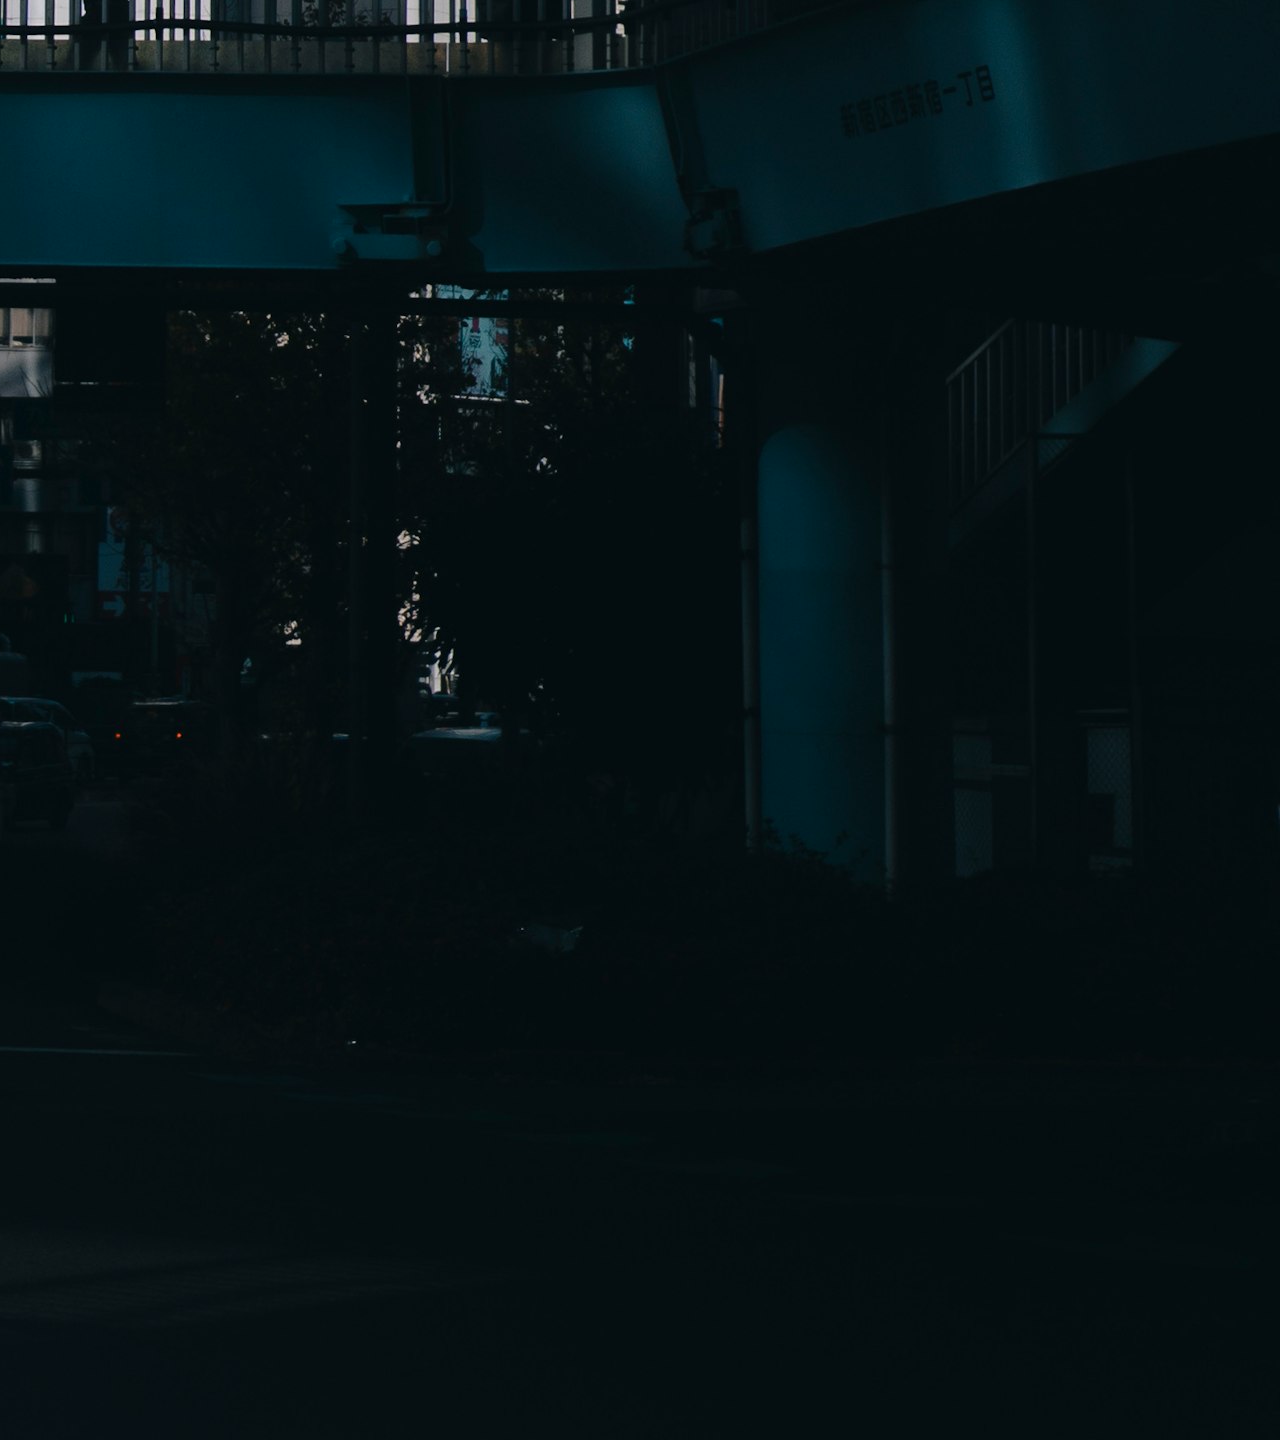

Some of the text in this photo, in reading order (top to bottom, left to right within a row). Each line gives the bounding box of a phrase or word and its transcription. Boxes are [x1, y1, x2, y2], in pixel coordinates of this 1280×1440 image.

[840, 64, 995, 139] 新宿区西新宿一丁目
